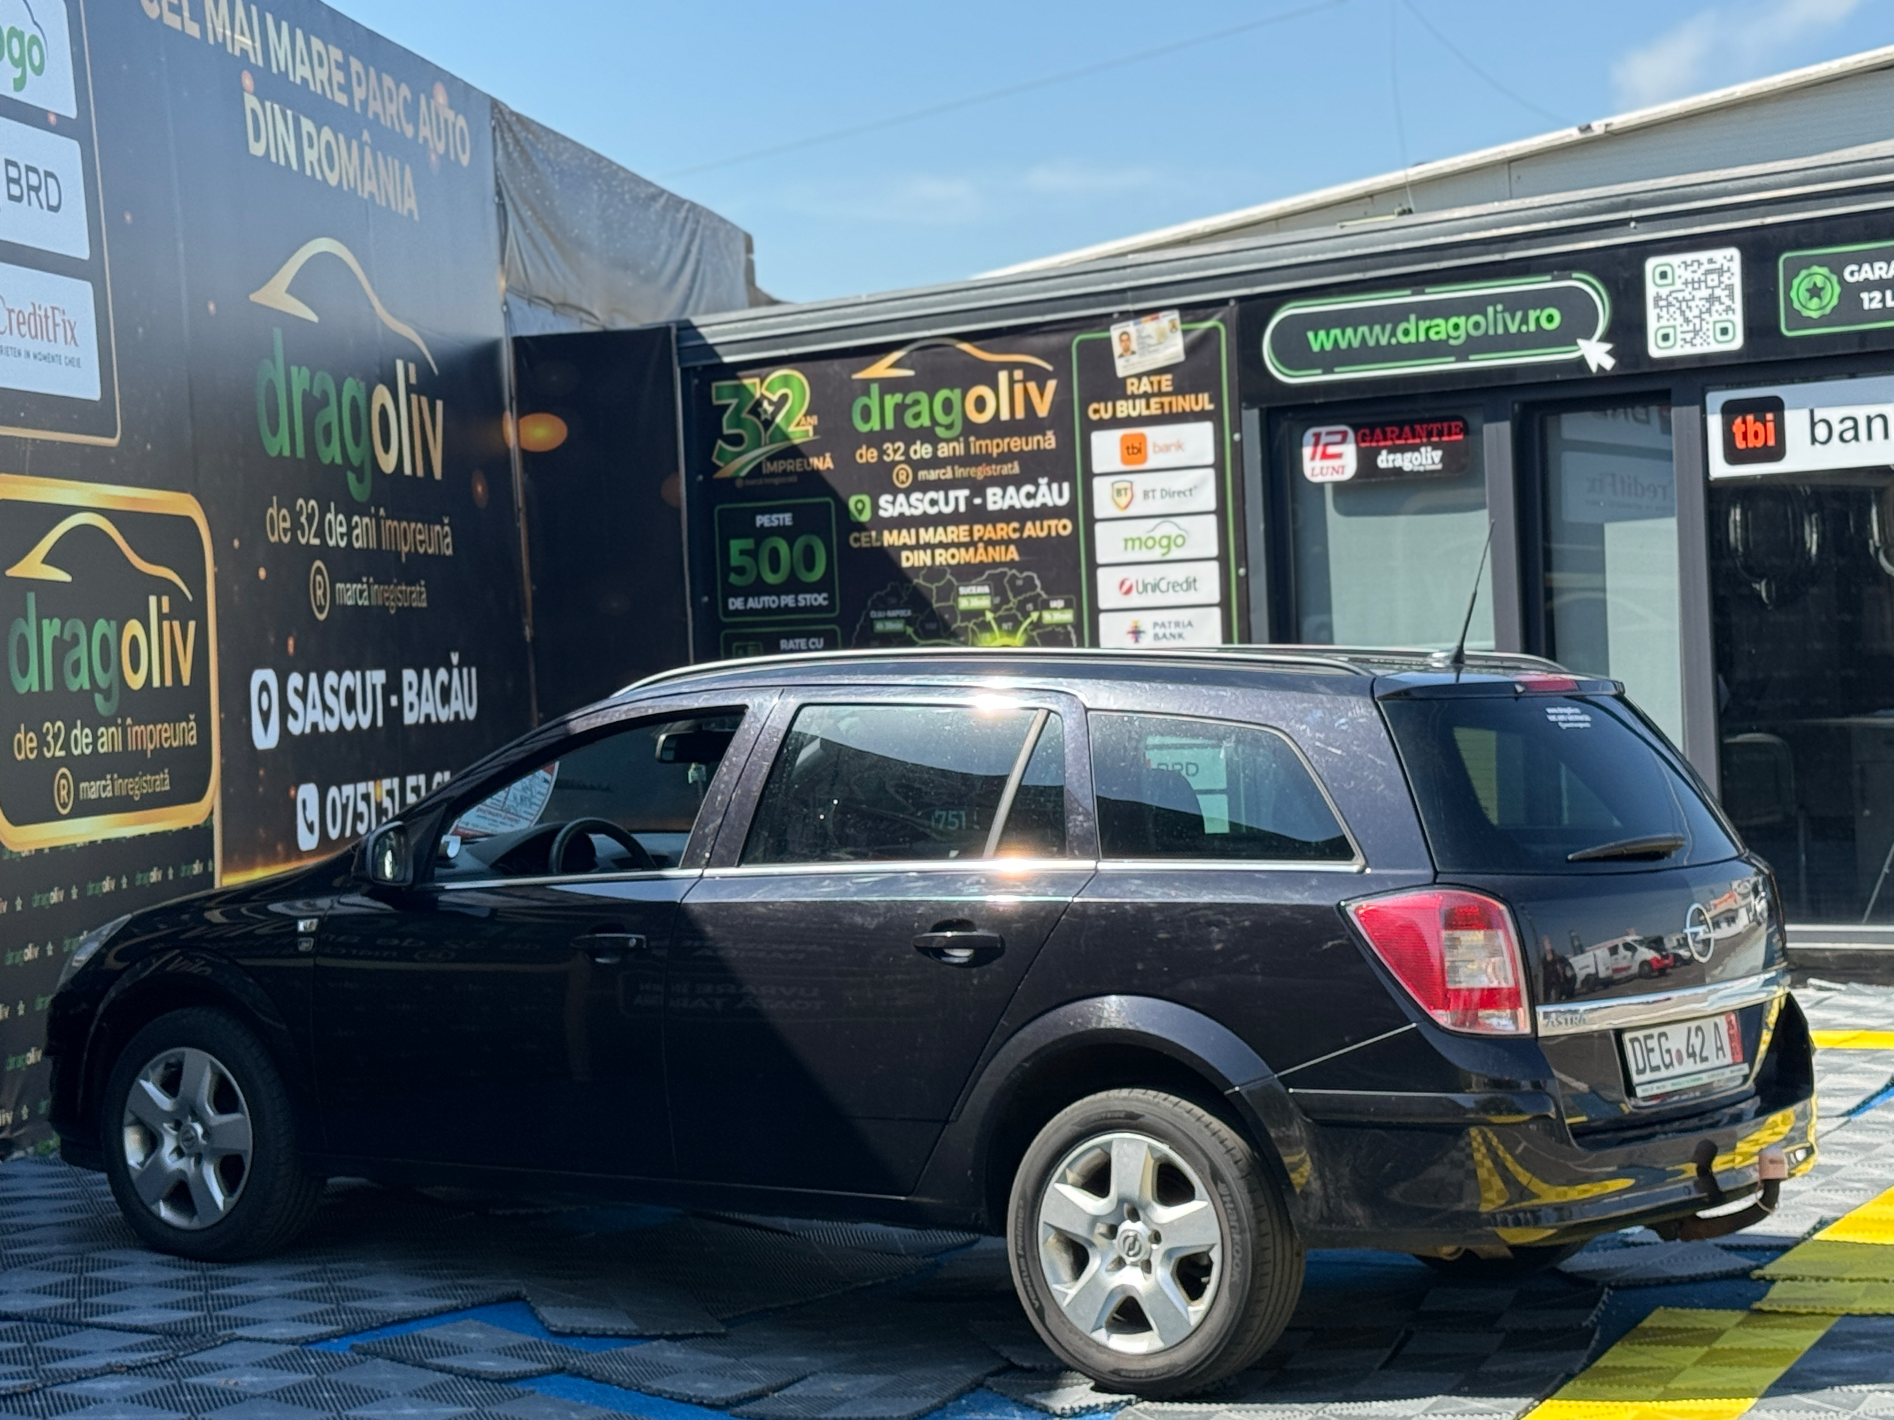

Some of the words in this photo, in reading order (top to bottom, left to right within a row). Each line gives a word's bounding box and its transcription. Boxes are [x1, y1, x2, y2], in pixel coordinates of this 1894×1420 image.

[0, 24, 45, 92] go
[204, 0, 263, 67] MAI
[265, 12, 348, 107] MARE
[350, 56, 414, 139] PARC
[418, 92, 470, 167] AUTO
[244, 92, 298, 171] DIN
[301, 115, 419, 221] ROMÂNIA
[4, 157, 62, 213] BRD
[1859, 291, 1883, 310] 12
[1306, 303, 1562, 353] www.dragoliv.ro
[1126, 374, 1174, 395] RATE
[255, 327, 443, 502] dragoliv
[852, 370, 1057, 438] dragoliv
[1087, 402, 1113, 420] CU
[1115, 393, 1215, 418] BULETINUL
[800, 414, 818, 427] ANI
[1357, 421, 1463, 448] GARANTIE
[1732, 412, 1776, 450] tbi
[1809, 408, 1889, 446] ban
[855, 445, 878, 463] de
[882, 442, 906, 461] 32
[909, 440, 933, 460] de
[937, 437, 965, 458] ani
[969, 430, 1057, 457] împreună
[1125, 442, 1142, 456] tbi
[1152, 440, 1184, 454] bank
[1310, 430, 1348, 461] 12
[1376, 446, 1443, 471] dragoliv
[762, 452, 834, 474] ÎMPREUNĂ
[918, 466, 953, 481] marcă
[954, 461, 1020, 480] înregistrată
[1311, 465, 1345, 478] LUNI
[878, 489, 970, 518] SASCUT
[986, 477, 1070, 511] BACĂU
[1116, 488, 1128, 497] BT
[1142, 490, 1156, 500] BT
[1160, 487, 1193, 499] Direct
[266, 496, 291, 544] de
[296, 498, 321, 545] 32
[325, 501, 347, 548] de
[352, 506, 377, 549] ani
[379, 507, 453, 563] împreună
[755, 513, 793, 528] PESTE
[849, 531, 881, 548] CEL
[882, 528, 916, 547] MAI
[918, 525, 970, 545] MARE
[973, 522, 1020, 541] PARC
[1022, 518, 1073, 538] AUTO
[728, 535, 827, 586] 500
[900, 549, 932, 567] DIN
[934, 542, 1020, 566] ROMÂNIA
[1123, 534, 1186, 557] mogo
[336, 576, 369, 606] marcă
[369, 577, 427, 614] înregistrată
[1136, 577, 1198, 594] UniCredit
[728, 598, 745, 610] DE
[746, 595, 779, 609] AUTO
[780, 595, 796, 608] PE
[797, 593, 829, 606] STOC
[1153, 620, 1194, 630] PATRIA
[1153, 632, 1185, 642] BANK
[8, 592, 196, 717] dragoliv
[779, 639, 807, 650] RATE
[808, 637, 824, 649] CU
[287, 670, 387, 735] SASCUT
[402, 651, 478, 725] BACĂU
[13, 723, 38, 761] de
[42, 720, 66, 758] 32
[70, 719, 93, 756] de
[97, 717, 123, 753] ani
[126, 714, 197, 759] împreună
[79, 774, 113, 800] marcă
[114, 768, 170, 801] înregistrată
[326, 780, 376, 840] 0751
[1628, 1028, 1674, 1076] DEG
[1686, 1023, 1708, 1065] 42
[1713, 1021, 1727, 1060] A
